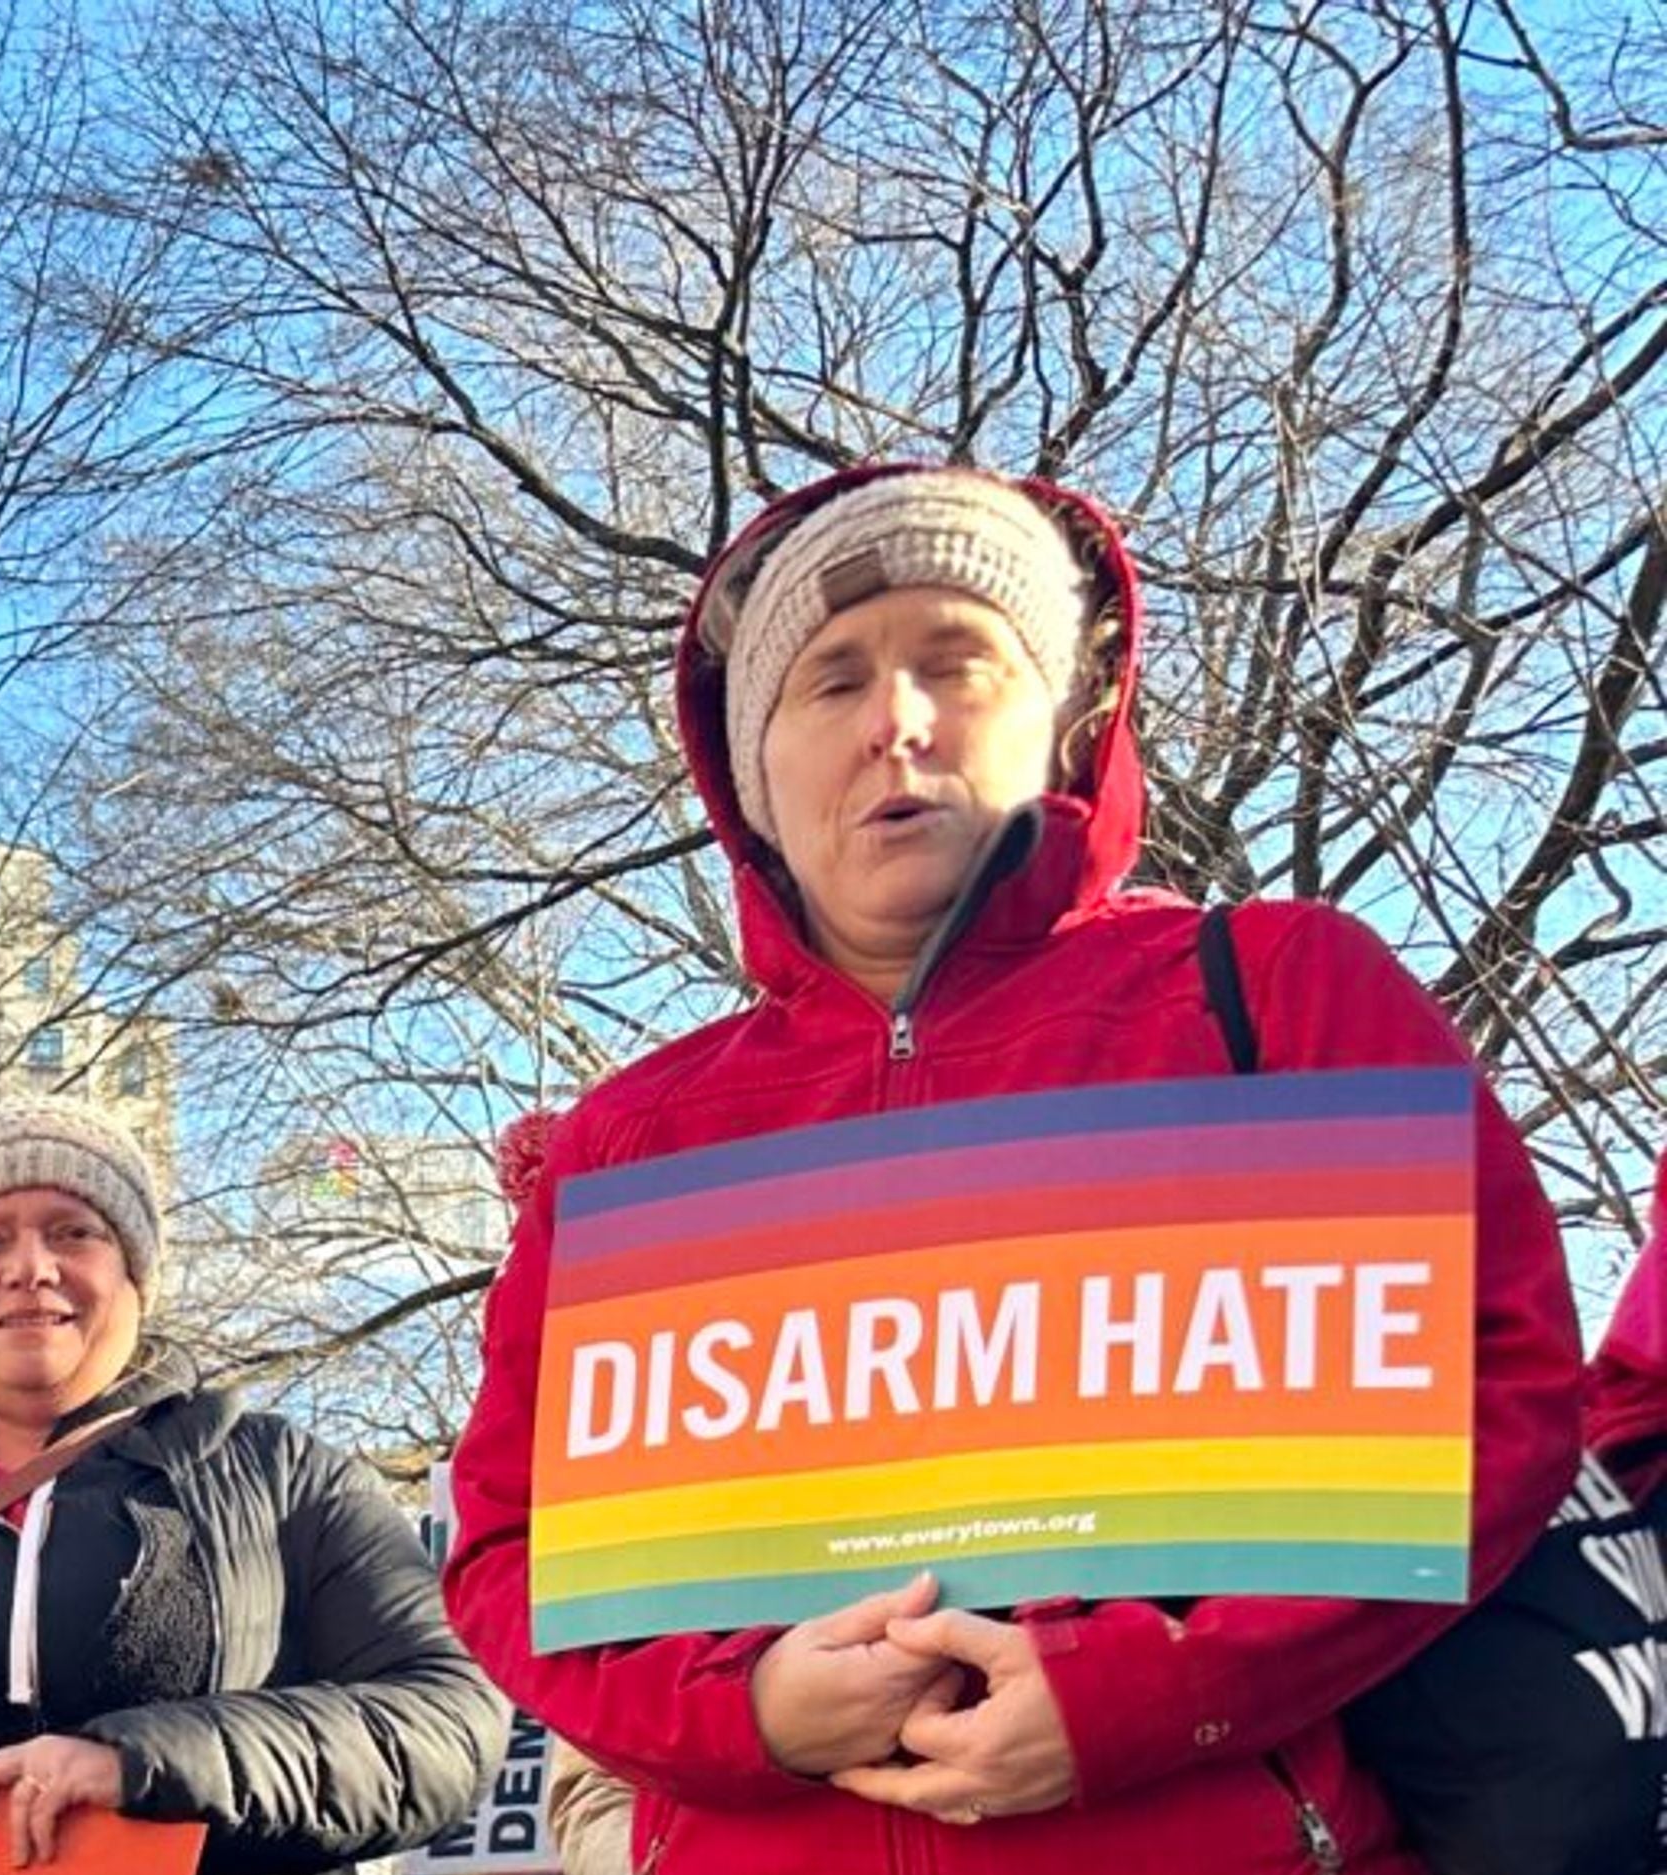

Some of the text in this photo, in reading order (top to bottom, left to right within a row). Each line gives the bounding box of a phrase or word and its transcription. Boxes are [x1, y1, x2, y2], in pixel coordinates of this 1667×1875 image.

[565, 1261, 1435, 1460] DISARM HATE
[828, 1511, 1097, 1554] www.everytown.org
